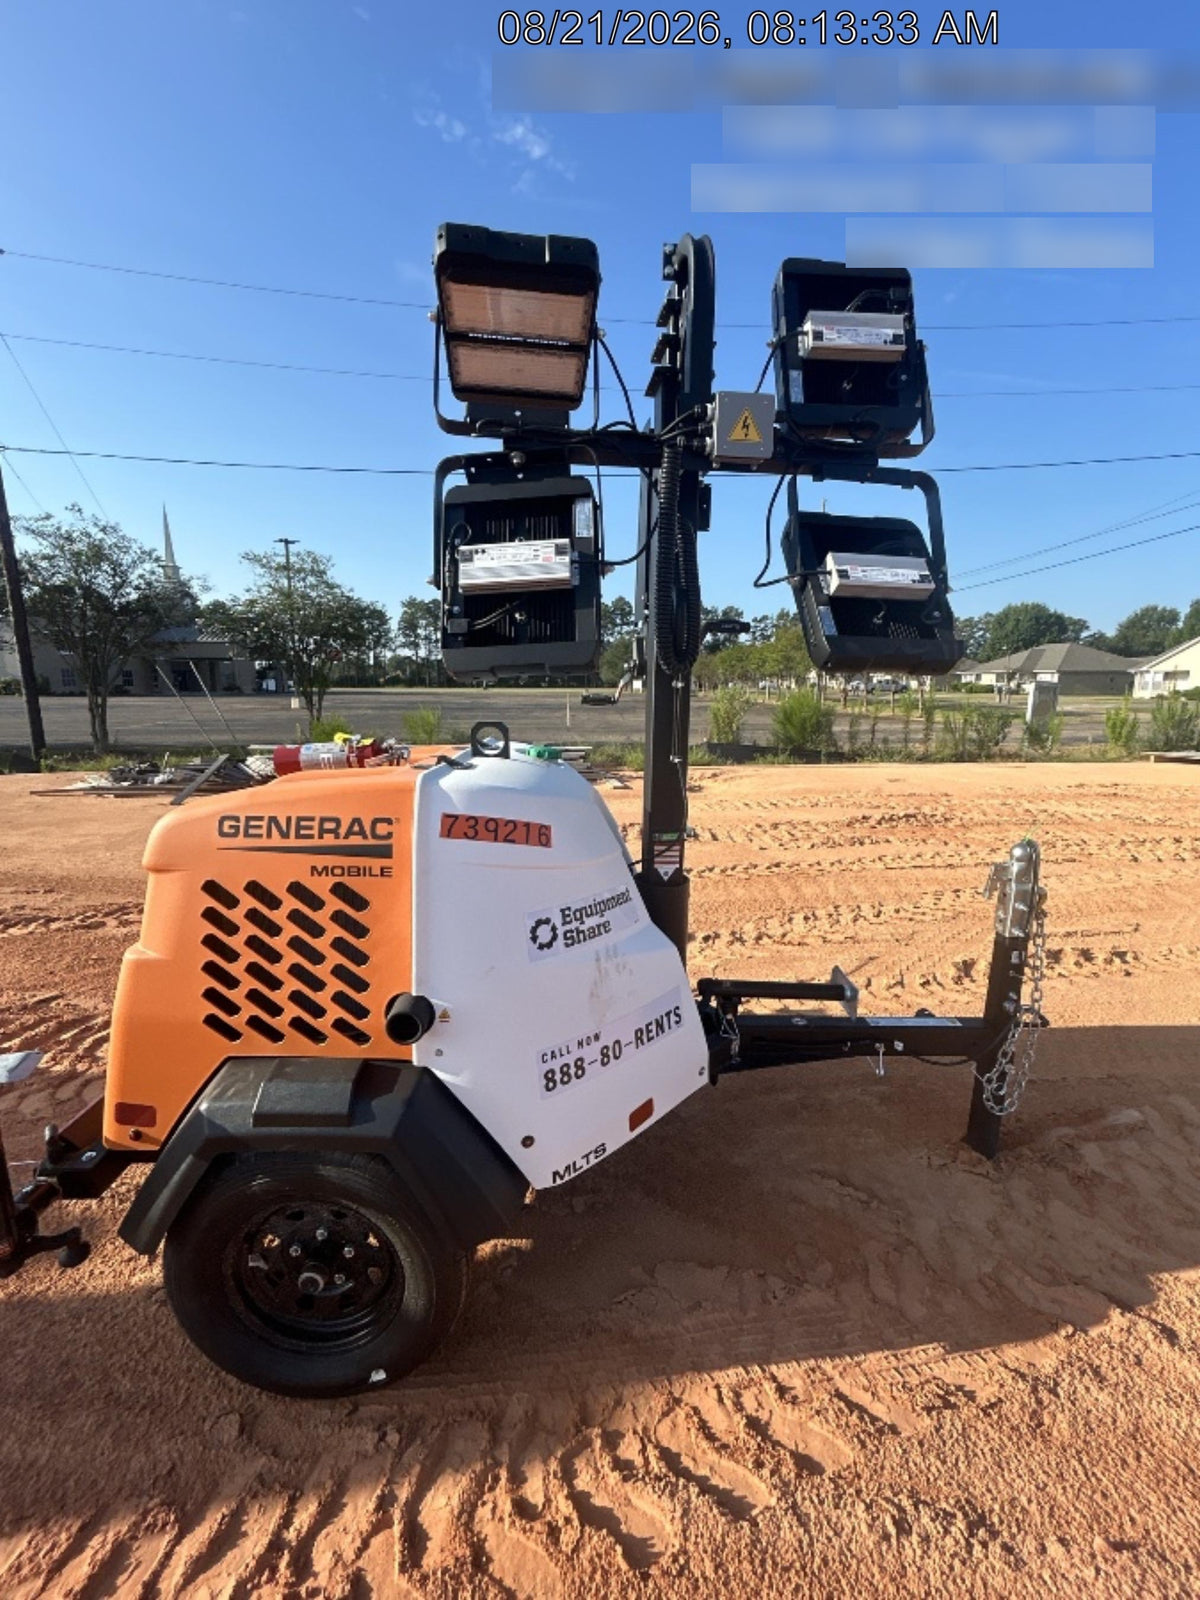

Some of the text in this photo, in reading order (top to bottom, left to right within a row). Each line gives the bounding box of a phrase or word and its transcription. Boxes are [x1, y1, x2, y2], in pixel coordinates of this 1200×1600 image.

[217, 815, 394, 841] GENERAC
[442, 814, 550, 846] 739216
[310, 865, 393, 878] MOBILE
[560, 888, 632, 926] Equipment
[563, 919, 612, 948] Share
[541, 1031, 602, 1064] CALL NOW
[551, 1142, 607, 1184] MLTS
